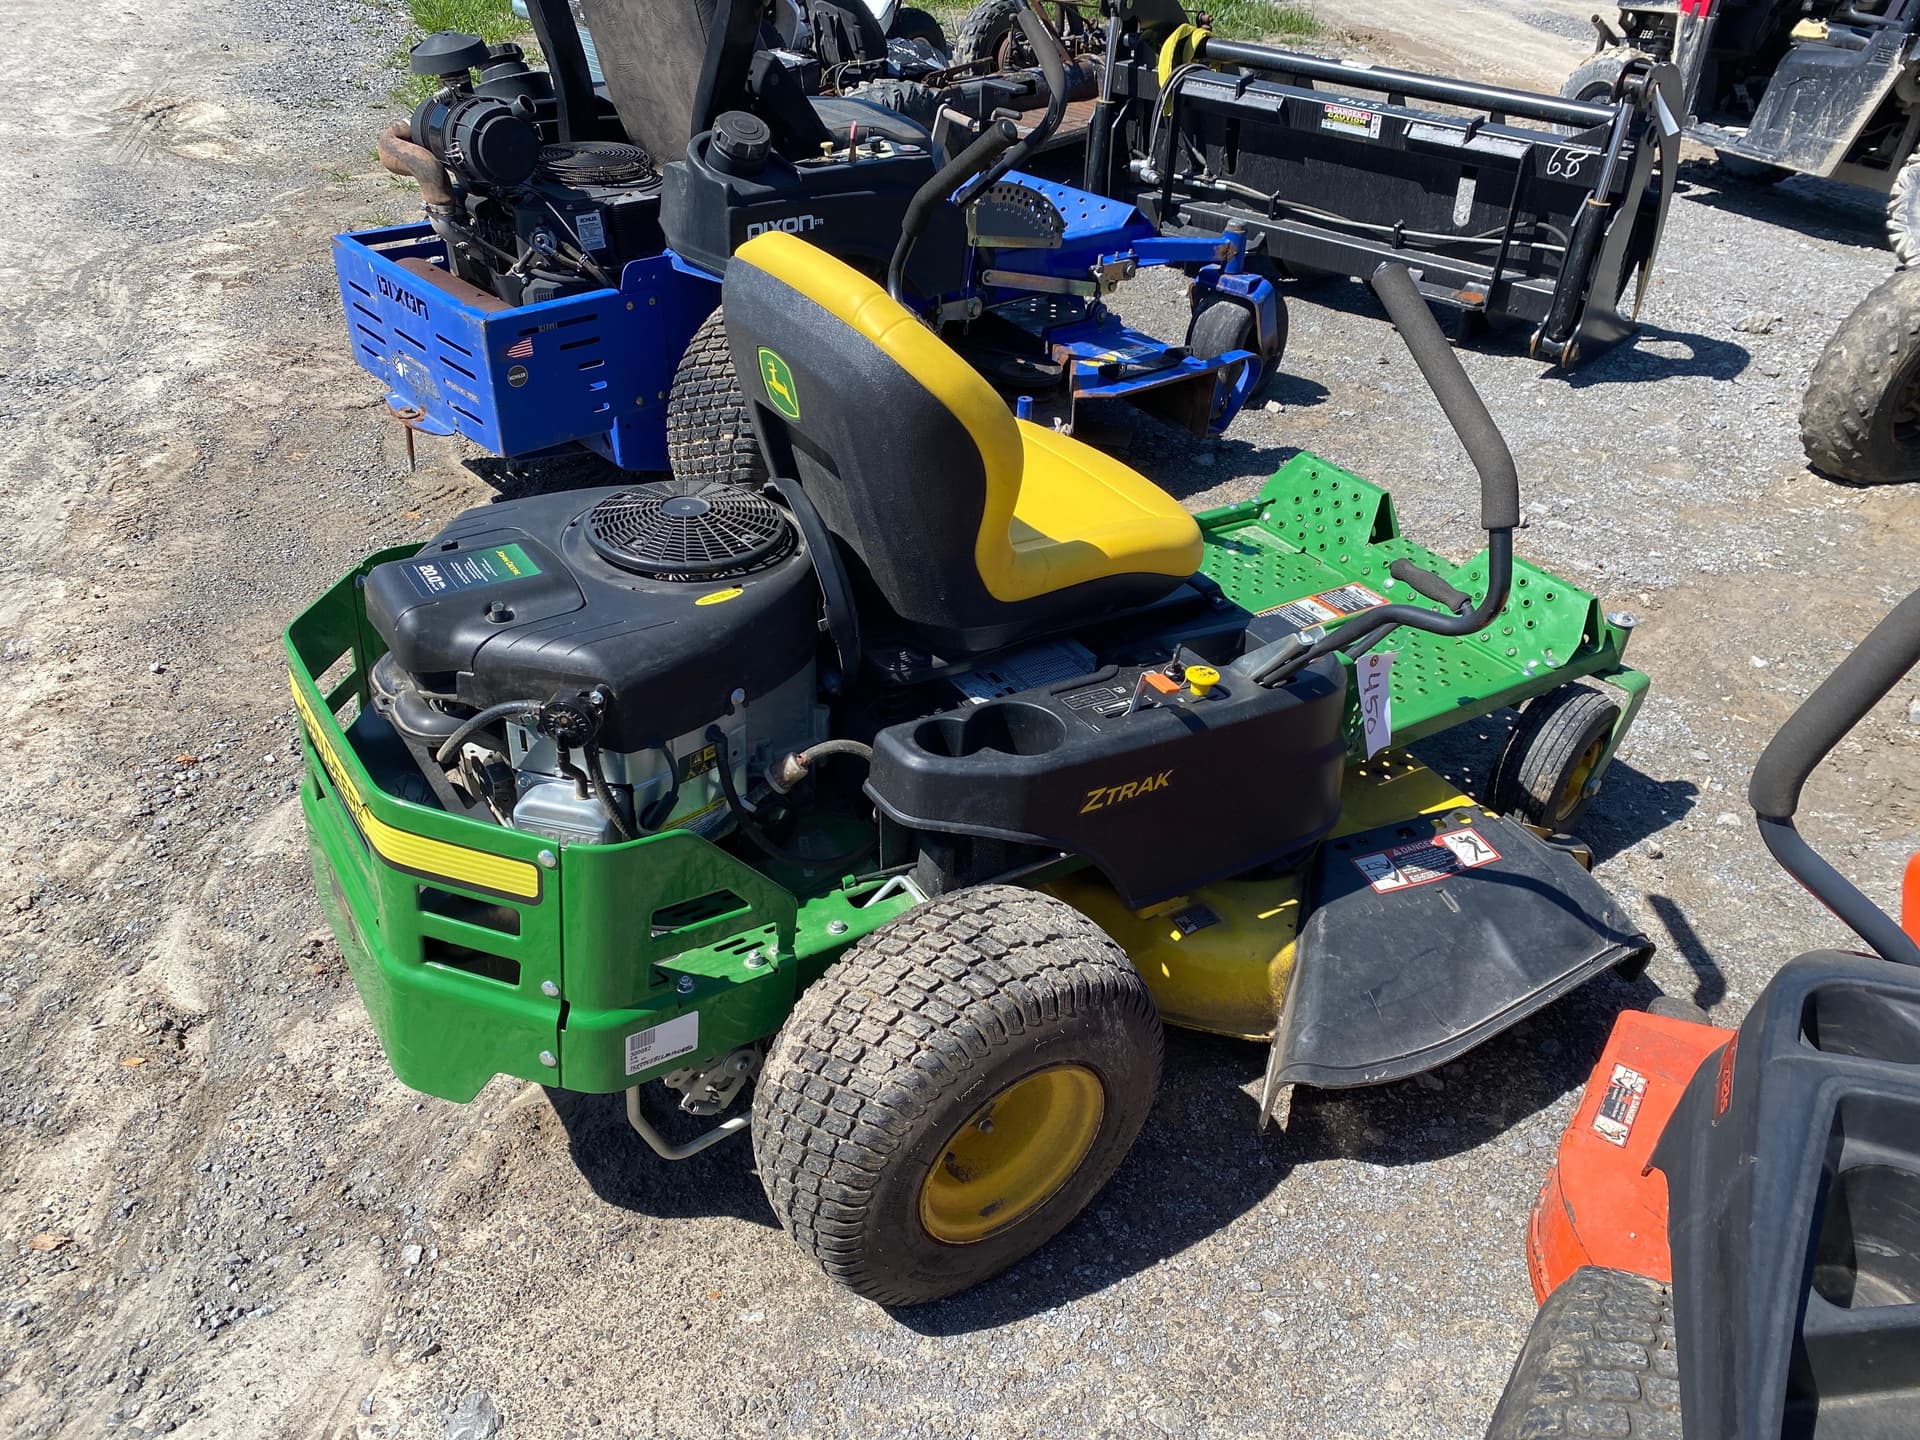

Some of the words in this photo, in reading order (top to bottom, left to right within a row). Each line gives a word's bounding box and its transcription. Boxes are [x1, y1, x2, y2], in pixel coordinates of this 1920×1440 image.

[1327, 112, 1367, 126] CAUTION
[1333, 106, 1361, 118] DANGER
[1546, 146, 1589, 179] 68
[1080, 769, 1175, 814] ZTRAK
